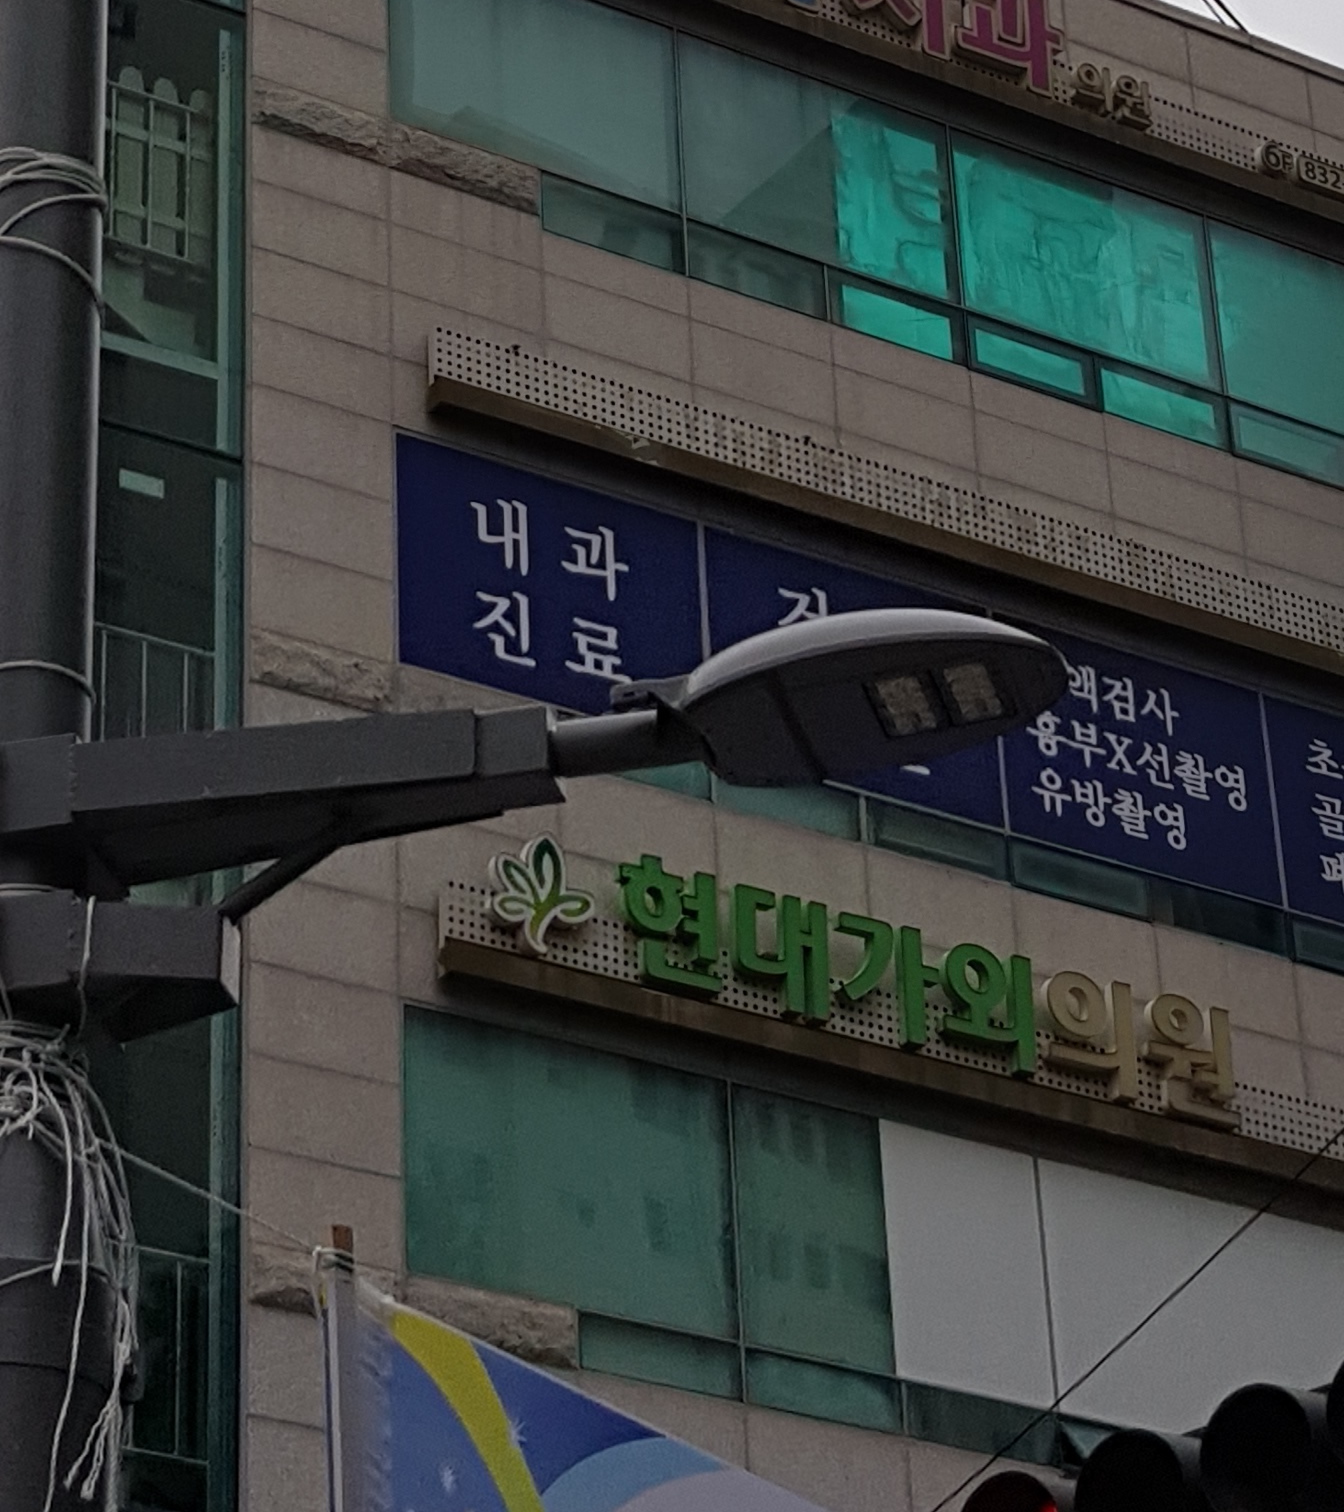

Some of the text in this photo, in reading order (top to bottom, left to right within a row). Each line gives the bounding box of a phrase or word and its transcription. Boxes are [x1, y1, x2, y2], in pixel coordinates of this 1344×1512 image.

[1071, 62, 1152, 131] 의원
[470, 499, 629, 601] 내과
[473, 591, 632, 684] 진료
[1069, 665, 1181, 736] 액검사
[1026, 711, 1247, 811] 흉부X선촬영
[1031, 767, 1187, 850] 유방촬영
[1041, 971, 1242, 1131] 의원
